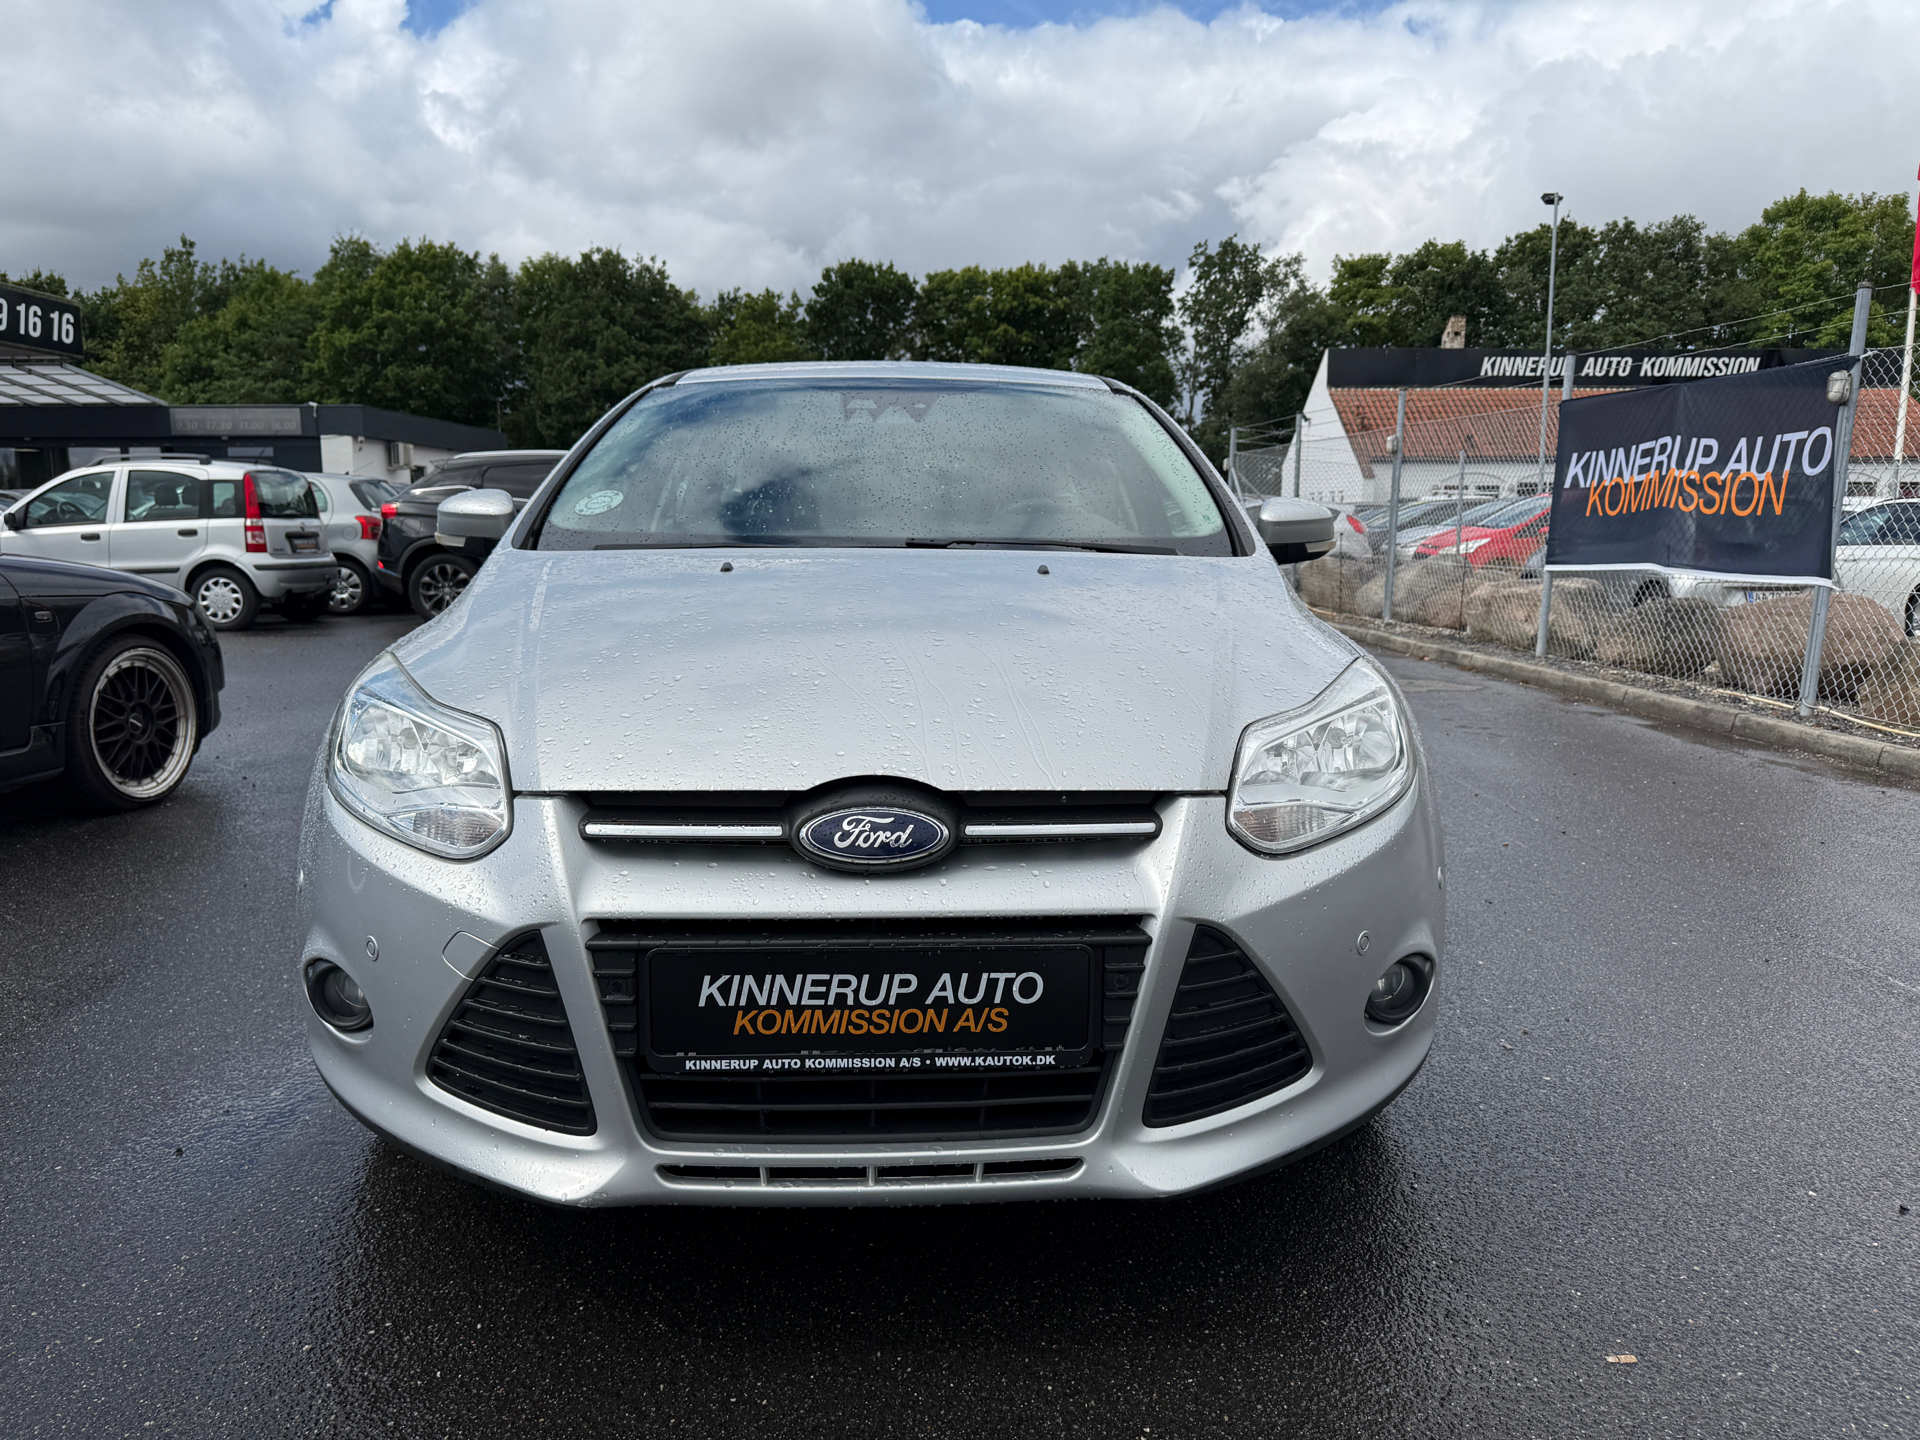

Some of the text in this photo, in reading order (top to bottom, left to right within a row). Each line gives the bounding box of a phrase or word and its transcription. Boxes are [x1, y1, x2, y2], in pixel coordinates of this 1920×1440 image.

[16, 303, 42, 338] 16
[49, 310, 75, 344] 16
[1480, 356, 1761, 377] KINNERU AUTO KOMMISSION
[1563, 426, 1833, 489] KINNERUP AUTO
[1585, 467, 1790, 517] KOMMISSION
[833, 815, 915, 849] Ford
[698, 971, 1044, 1008] KINNERUP AUTO
[732, 1007, 1010, 1035] KOMMISSION A/S
[685, 1059, 759, 1070] KINNERUP
[762, 1058, 801, 1069] AUTO
[805, 1057, 896, 1069] KOMMISSION
[899, 1057, 921, 1068] A/S
[935, 1054, 1056, 1067] WWW.KAUTOK.DK
